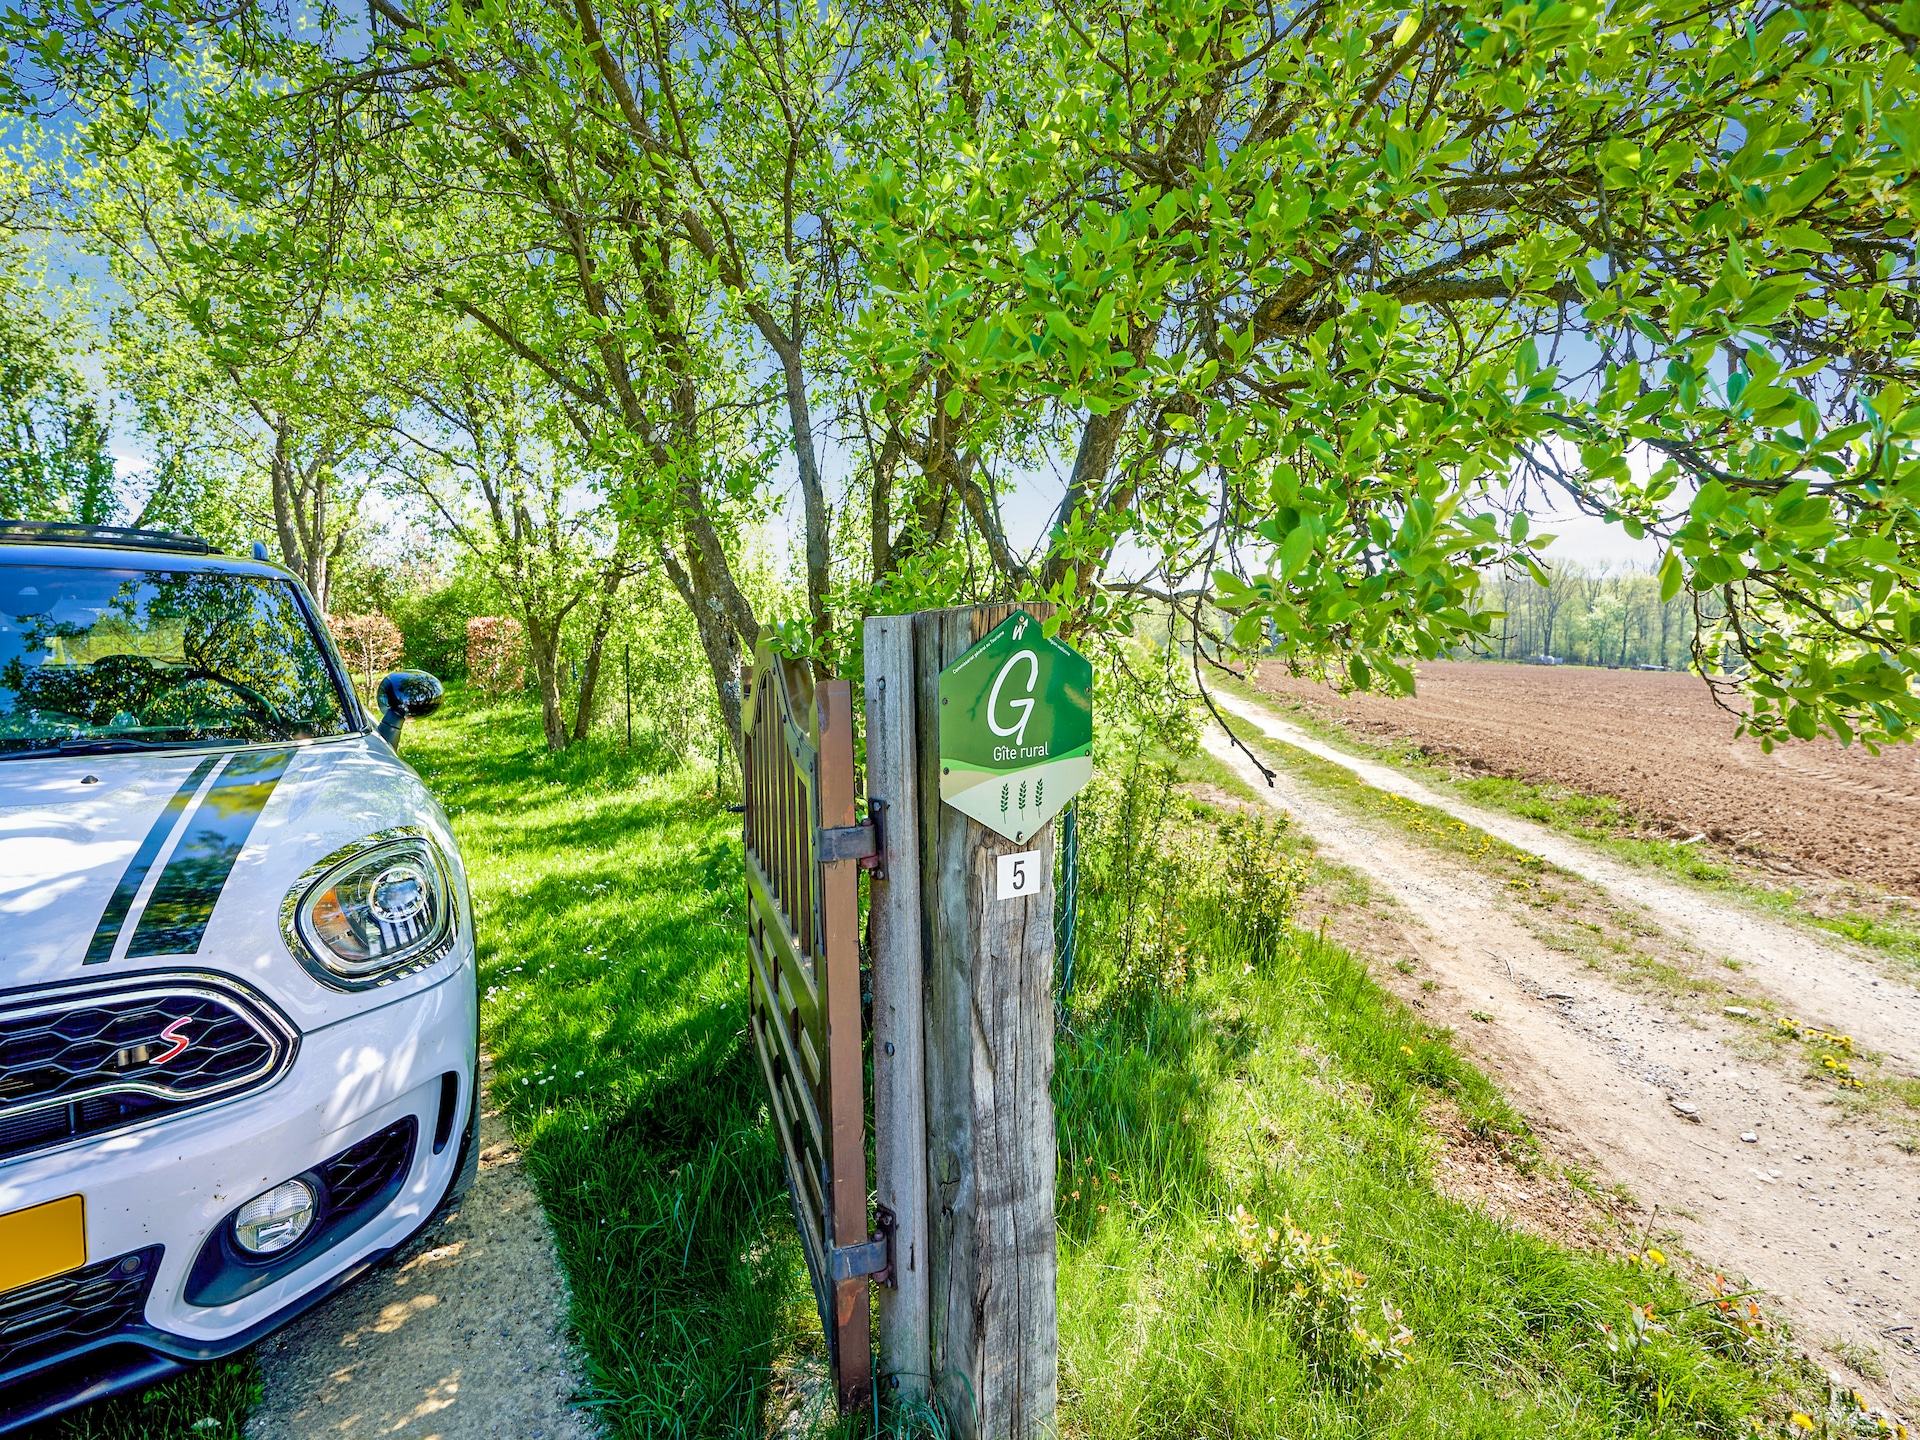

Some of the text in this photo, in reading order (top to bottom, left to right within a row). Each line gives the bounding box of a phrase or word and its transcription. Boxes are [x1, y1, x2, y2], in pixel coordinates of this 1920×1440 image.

[987, 649, 1039, 746] G
[993, 741, 1049, 762] Gîte rural
[1012, 860, 1026, 890] 5
[149, 1016, 193, 1065] S
